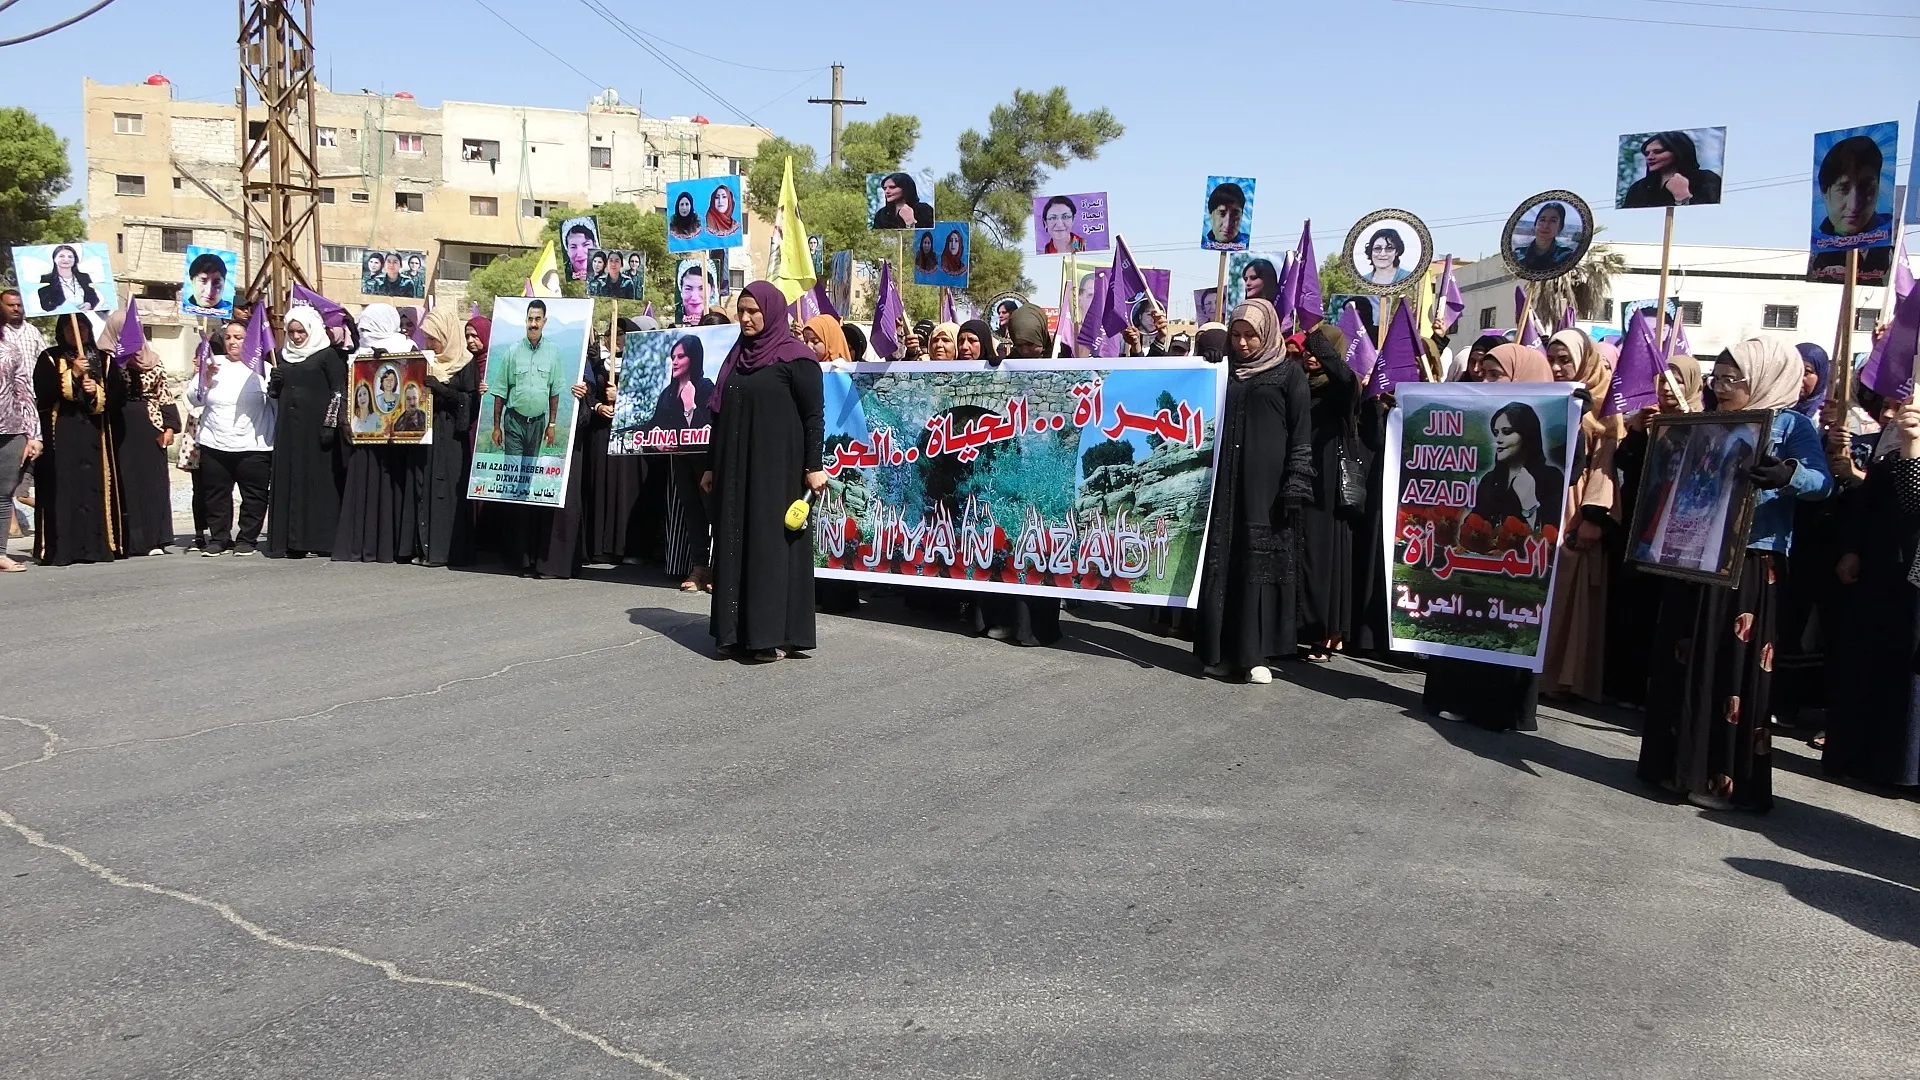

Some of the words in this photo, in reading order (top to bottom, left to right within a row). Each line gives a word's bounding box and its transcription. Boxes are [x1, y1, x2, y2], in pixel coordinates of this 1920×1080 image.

[1082, 211, 1104, 222] الحياة
[680, 424, 712, 445] EMÎ
[926, 396, 1028, 463] الحياة
[1424, 411, 1463, 436] JIN
[476, 462, 487, 470] EM
[545, 467, 561, 476] APO
[1405, 445, 1477, 472] JIYAN
[863, 495, 996, 570] JIYAN
[1403, 520, 1548, 579] المرأة
[1396, 584, 1462, 618] الحرية
